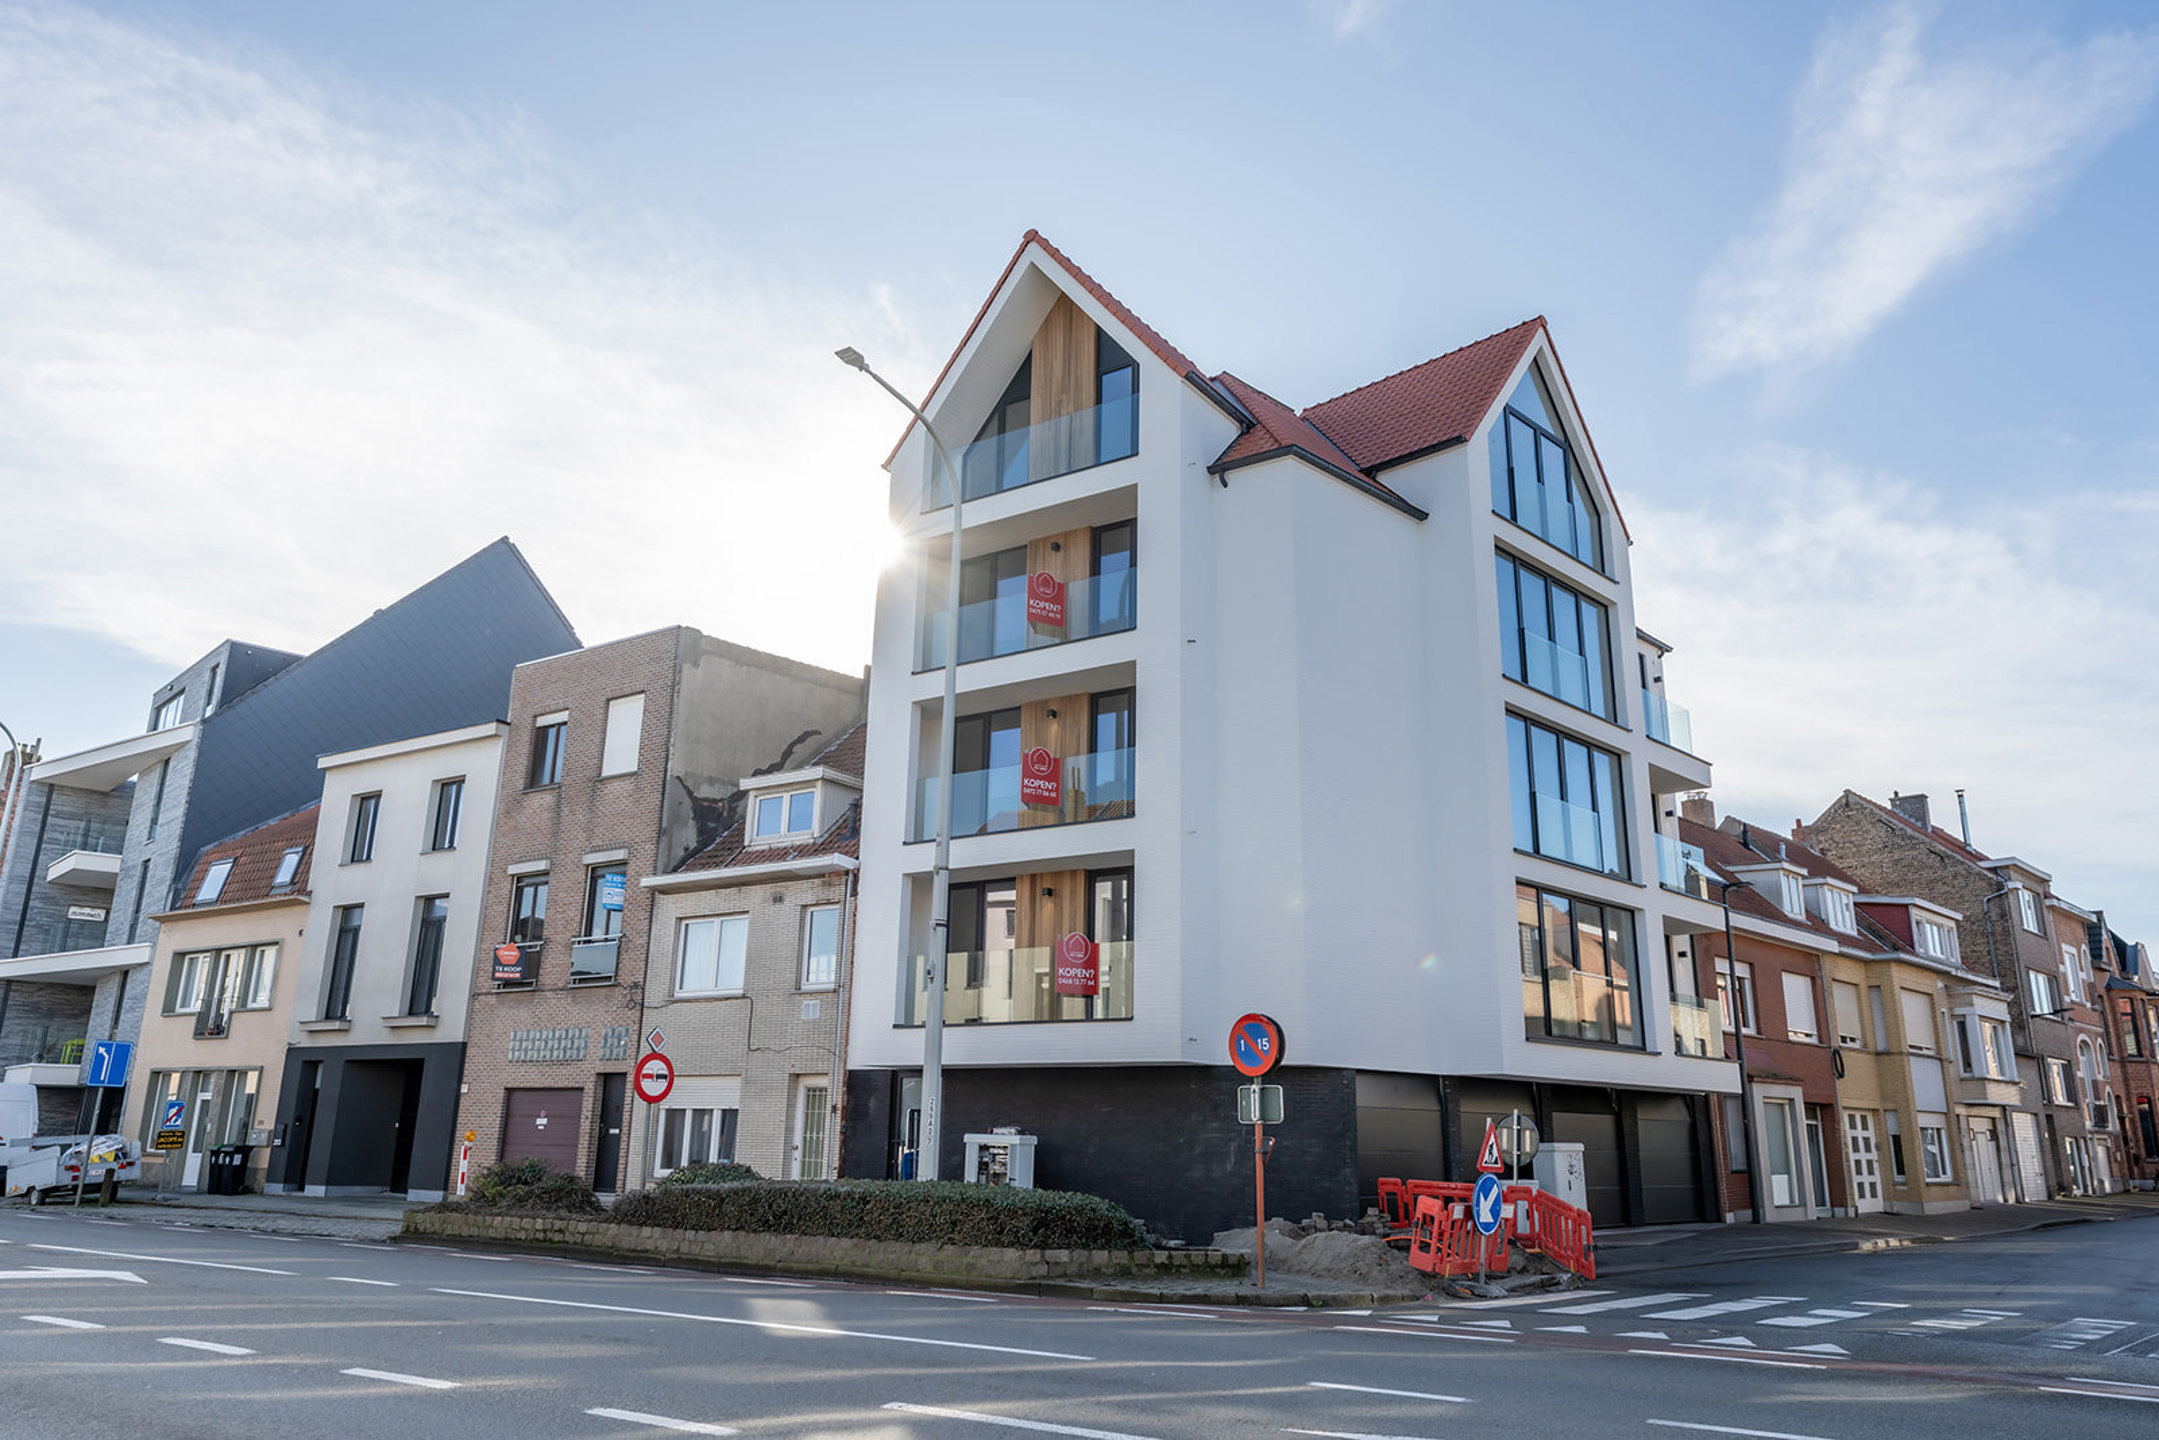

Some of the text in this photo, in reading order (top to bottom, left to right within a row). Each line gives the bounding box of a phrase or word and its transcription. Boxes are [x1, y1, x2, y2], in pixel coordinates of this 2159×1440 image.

[1029, 598, 1062, 612] KOPEN?
[1024, 778, 1057, 791] KOPEN?
[1058, 967, 1095, 978] KOPEN?
[1240, 1038, 1270, 1052] 1 15
